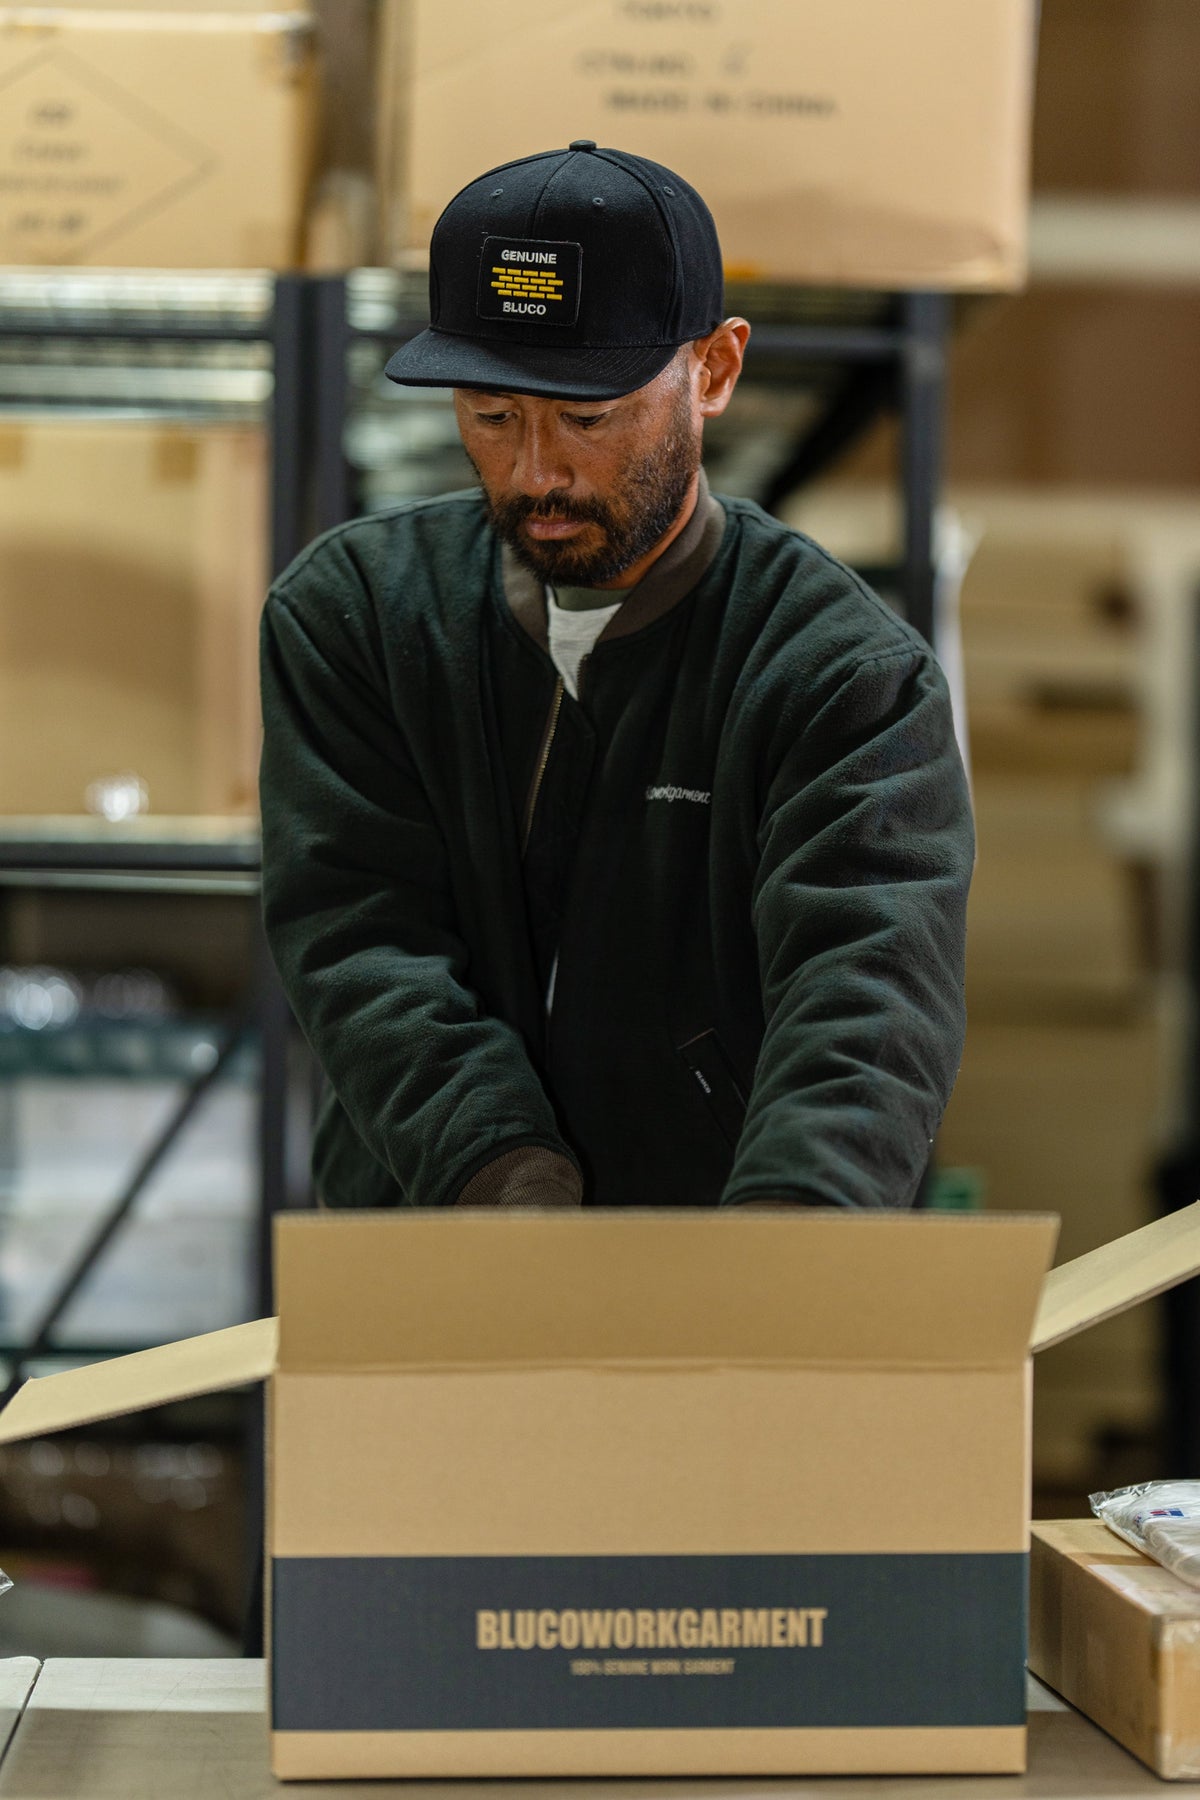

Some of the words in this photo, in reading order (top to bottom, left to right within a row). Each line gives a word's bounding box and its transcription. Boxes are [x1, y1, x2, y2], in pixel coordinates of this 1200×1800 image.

[501, 249, 557, 265] GENUINE
[502, 301, 547, 316] BLUCO
[476, 1608, 827, 1650] BLUCOWORKGARMENT
